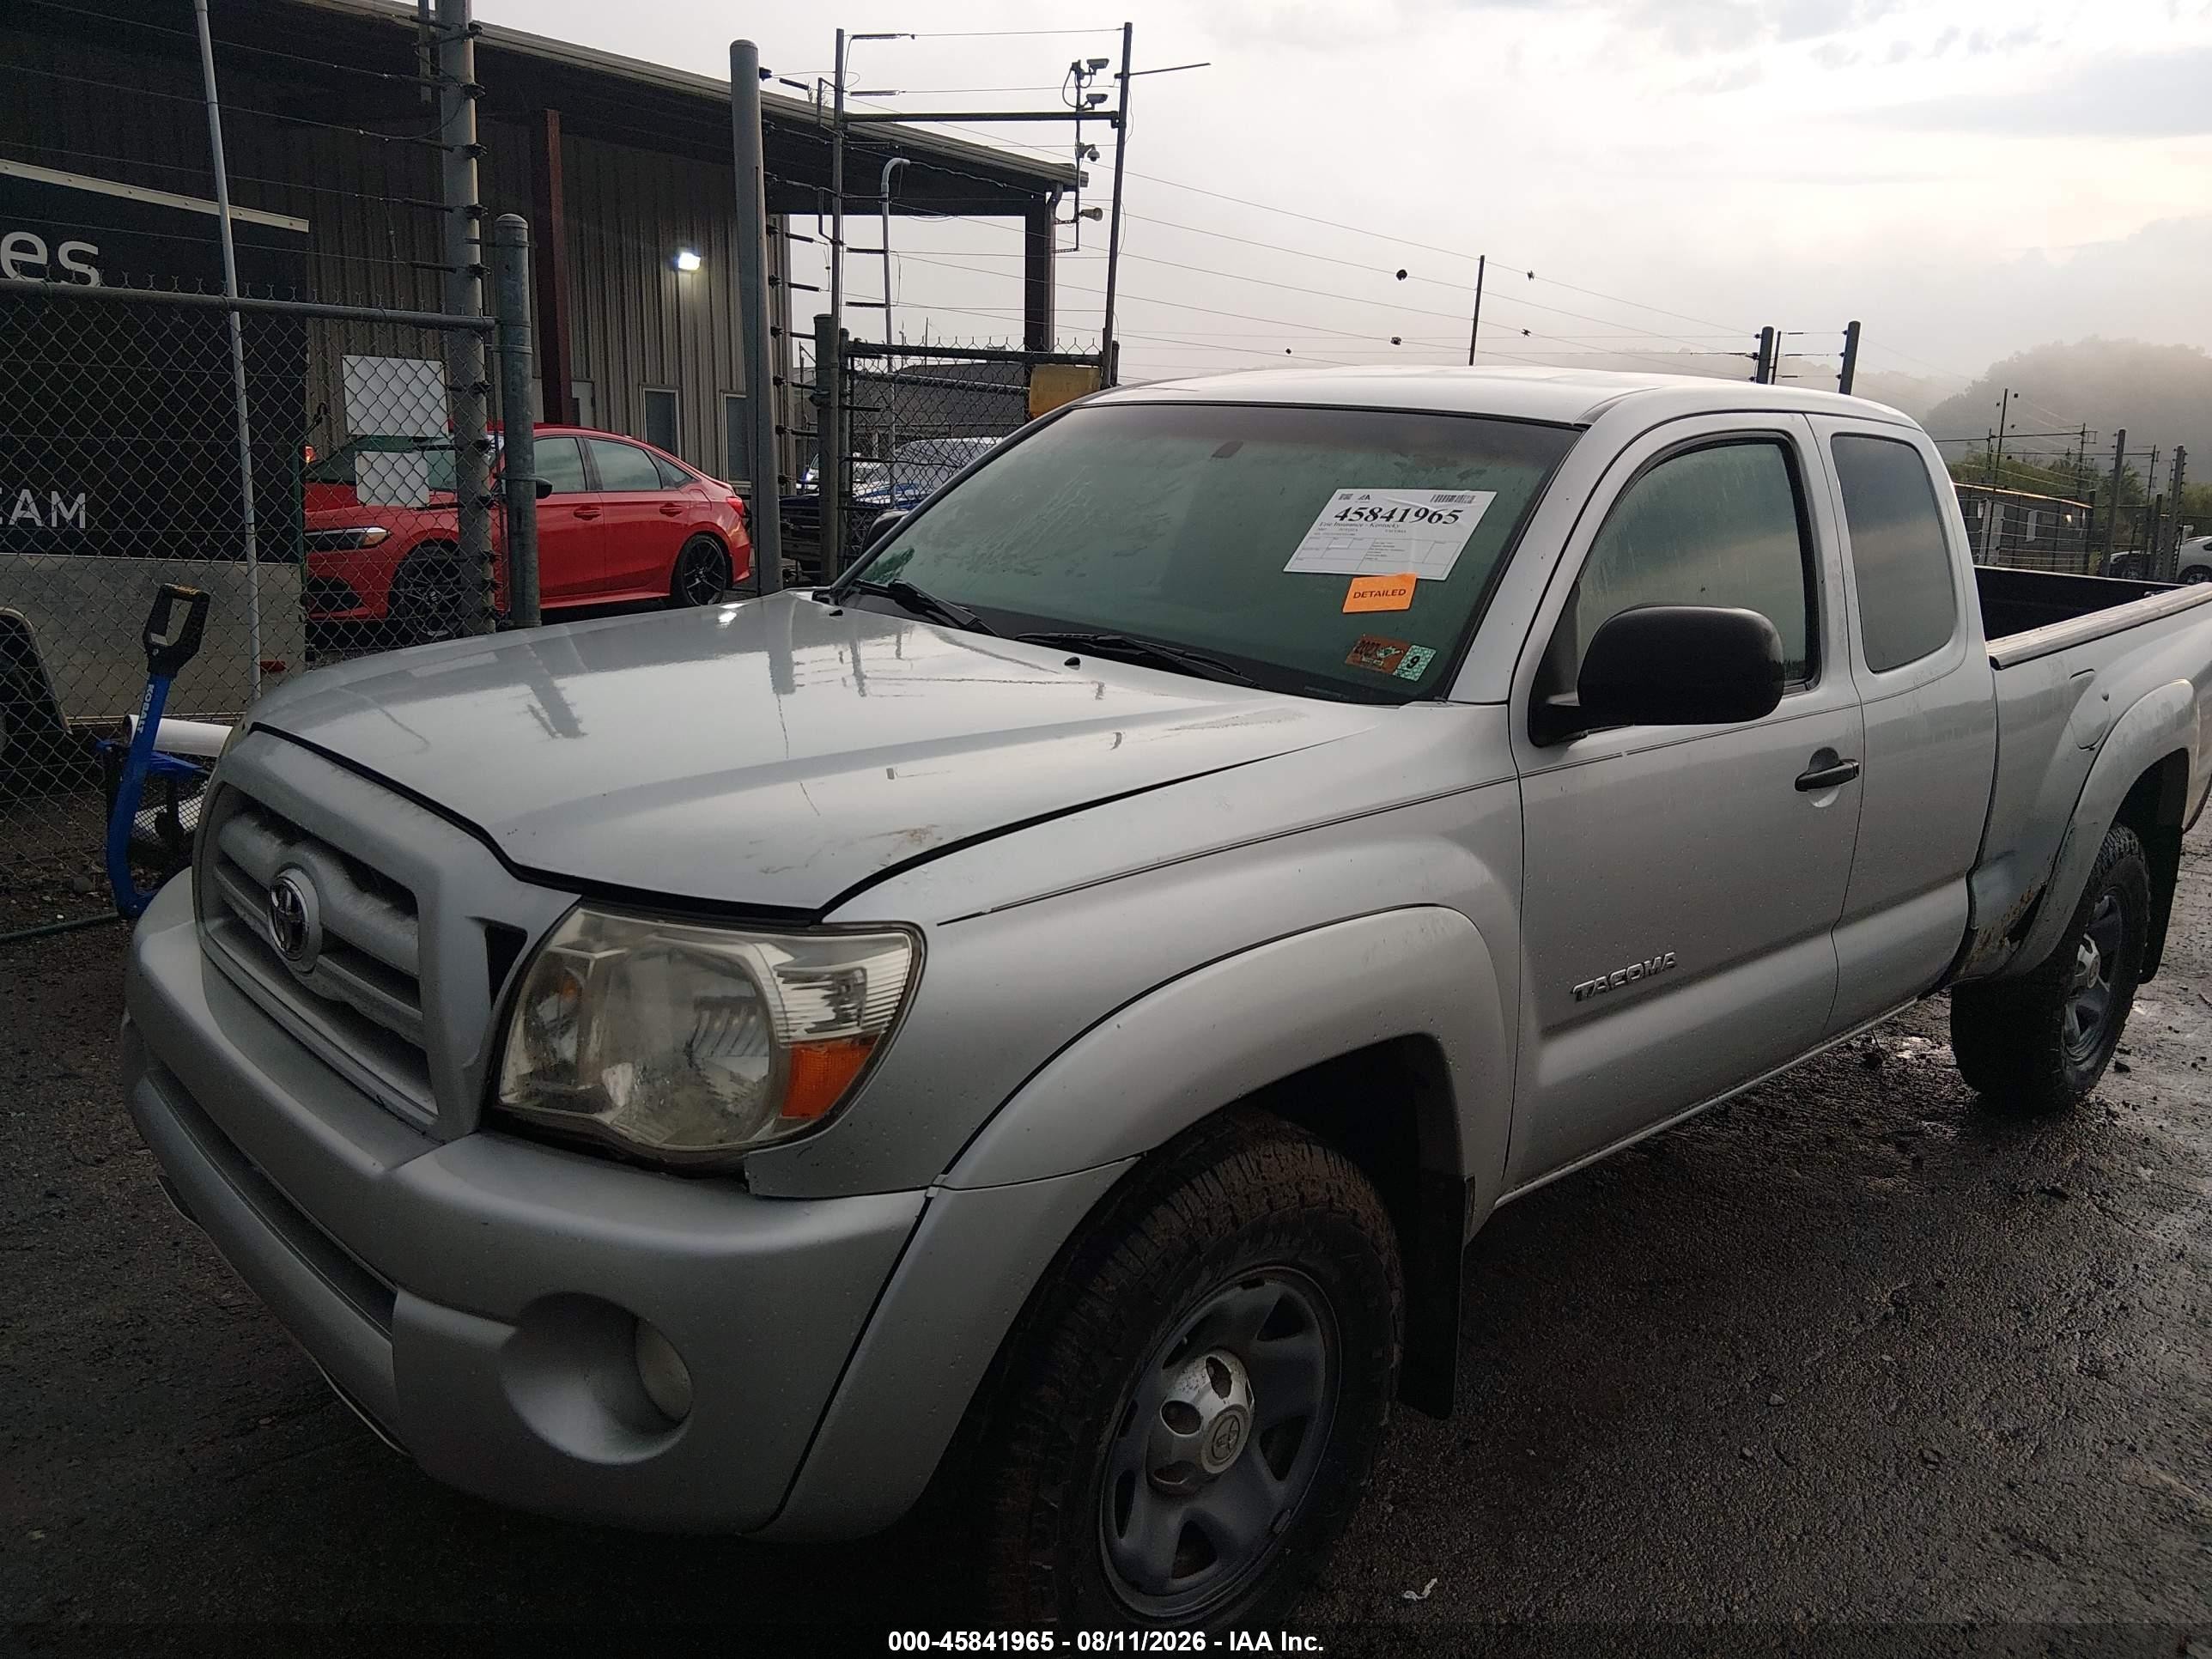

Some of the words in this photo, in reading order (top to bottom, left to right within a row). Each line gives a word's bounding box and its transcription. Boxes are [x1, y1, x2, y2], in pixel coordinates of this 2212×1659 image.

[0, 487, 86, 529] AM
[1334, 507, 1464, 525] 45841965
[1353, 588, 1407, 599] DETAILED
[1406, 655, 1421, 669] 9
[137, 684, 155, 734] KOBALT
[1571, 951, 1677, 1002] TACOMA
